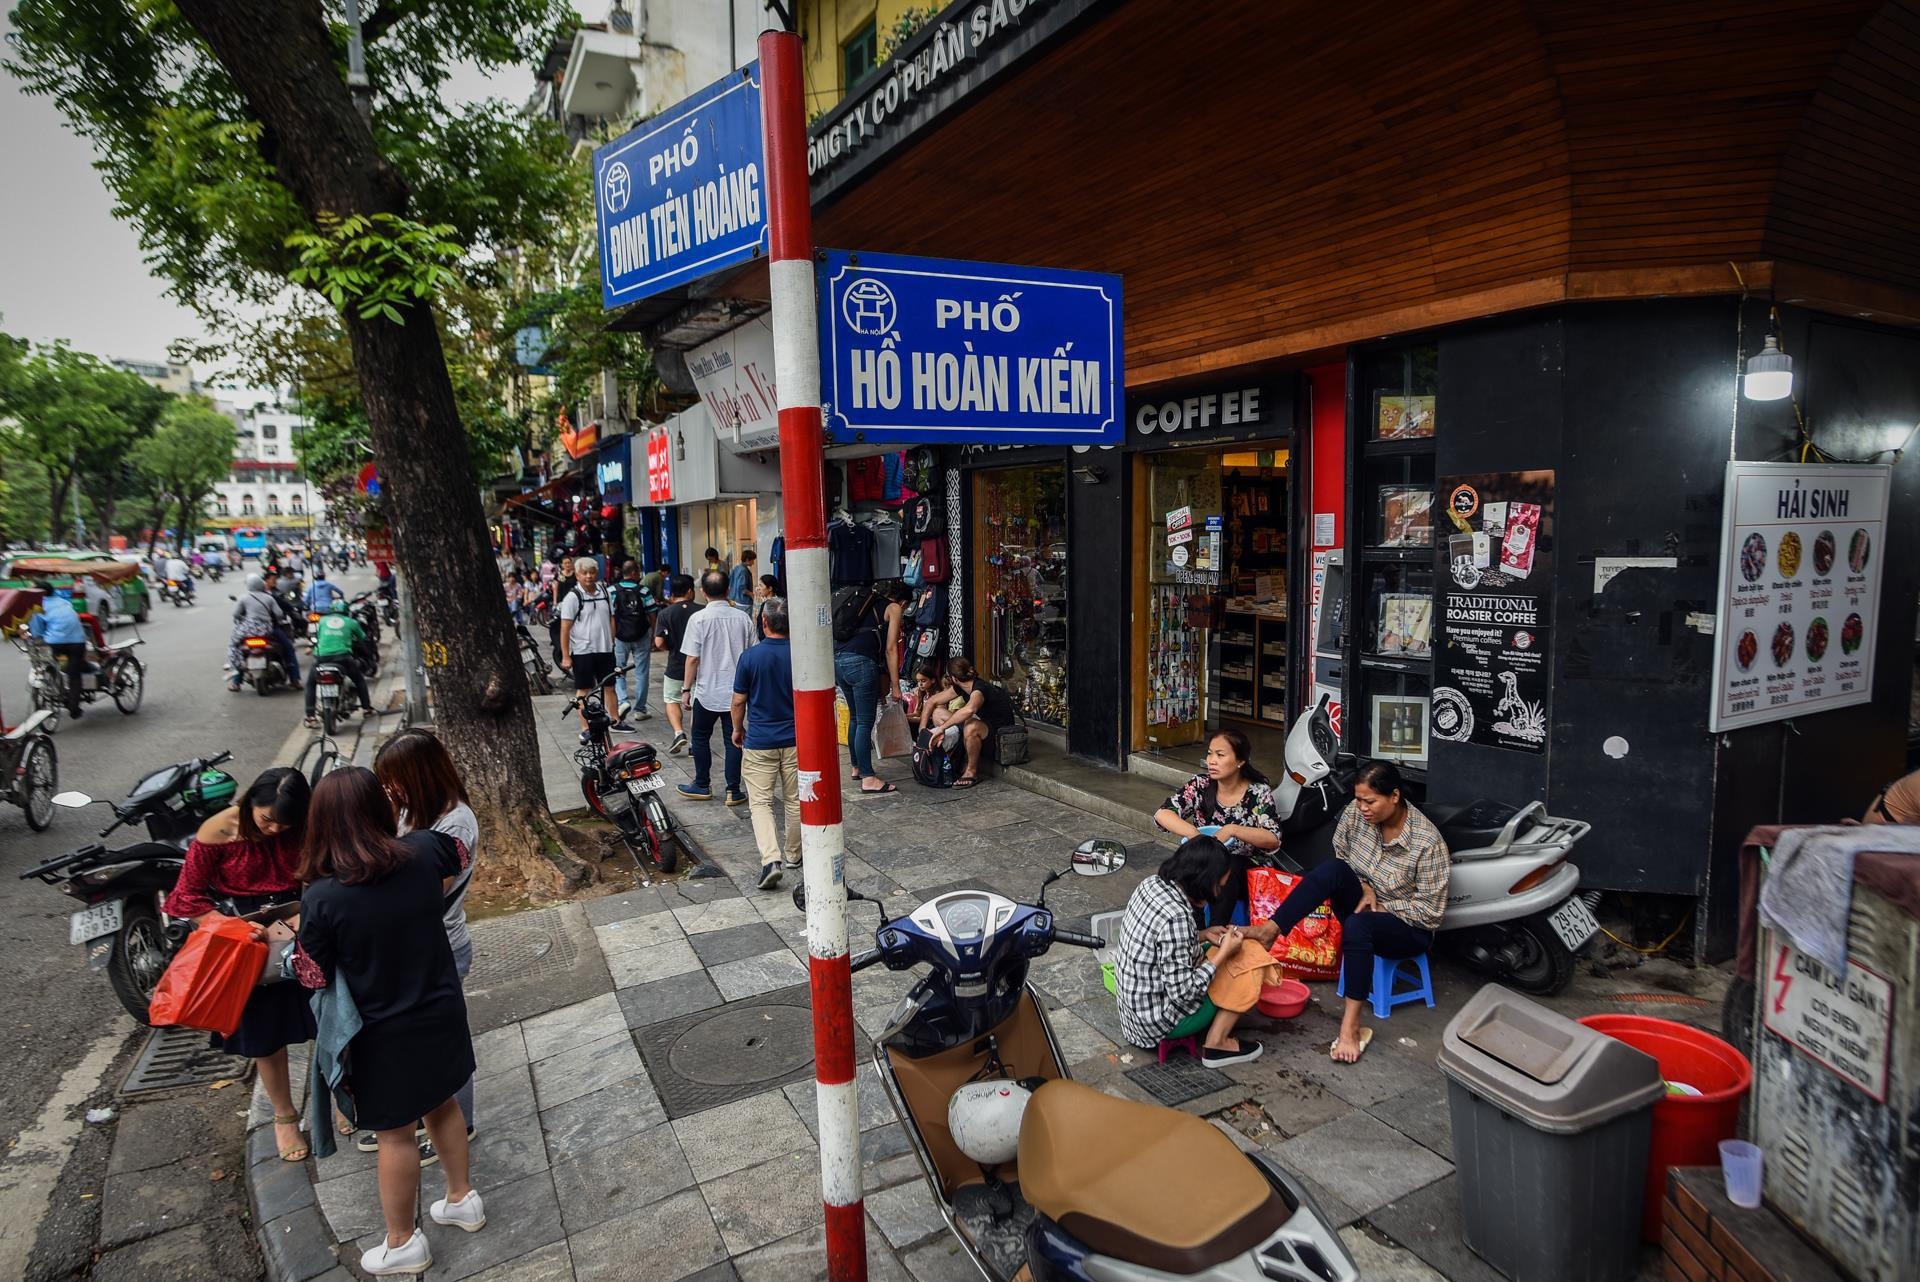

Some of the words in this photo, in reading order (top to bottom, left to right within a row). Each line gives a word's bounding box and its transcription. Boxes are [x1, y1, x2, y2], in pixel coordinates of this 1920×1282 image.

[649, 118, 699, 186] PHỐ
[807, 126, 841, 176] ÔNG
[843, 99, 867, 147] TY
[610, 212, 650, 278] ĐINH
[650, 188, 691, 262] TIÊN
[692, 163, 761, 246] HOÀNG
[935, 291, 1023, 333] PHỐ
[851, 331, 901, 410] HỒ
[911, 341, 1009, 412] HOÀN
[1018, 342, 1101, 415] KIẾM
[1136, 388, 1260, 434] COFFEE
[1777, 479, 1807, 519] HẢI
[1810, 489, 1849, 519] SINH
[1446, 595, 1538, 612] TRADITIONAL
[1446, 608, 1492, 622] ROASTER
[1494, 611, 1537, 625] COFFEE
[1446, 626, 1460, 635] Have
[1460, 628, 1471, 637] you
[1471, 628, 1493, 638] enjoyed
[1494, 629, 1503, 638] it?
[1453, 634, 1479, 643] Premium
[1480, 637, 1502, 646] coffees
[1554, 900, 1584, 931] 29-C1
[1562, 914, 1598, 948] 276.74
